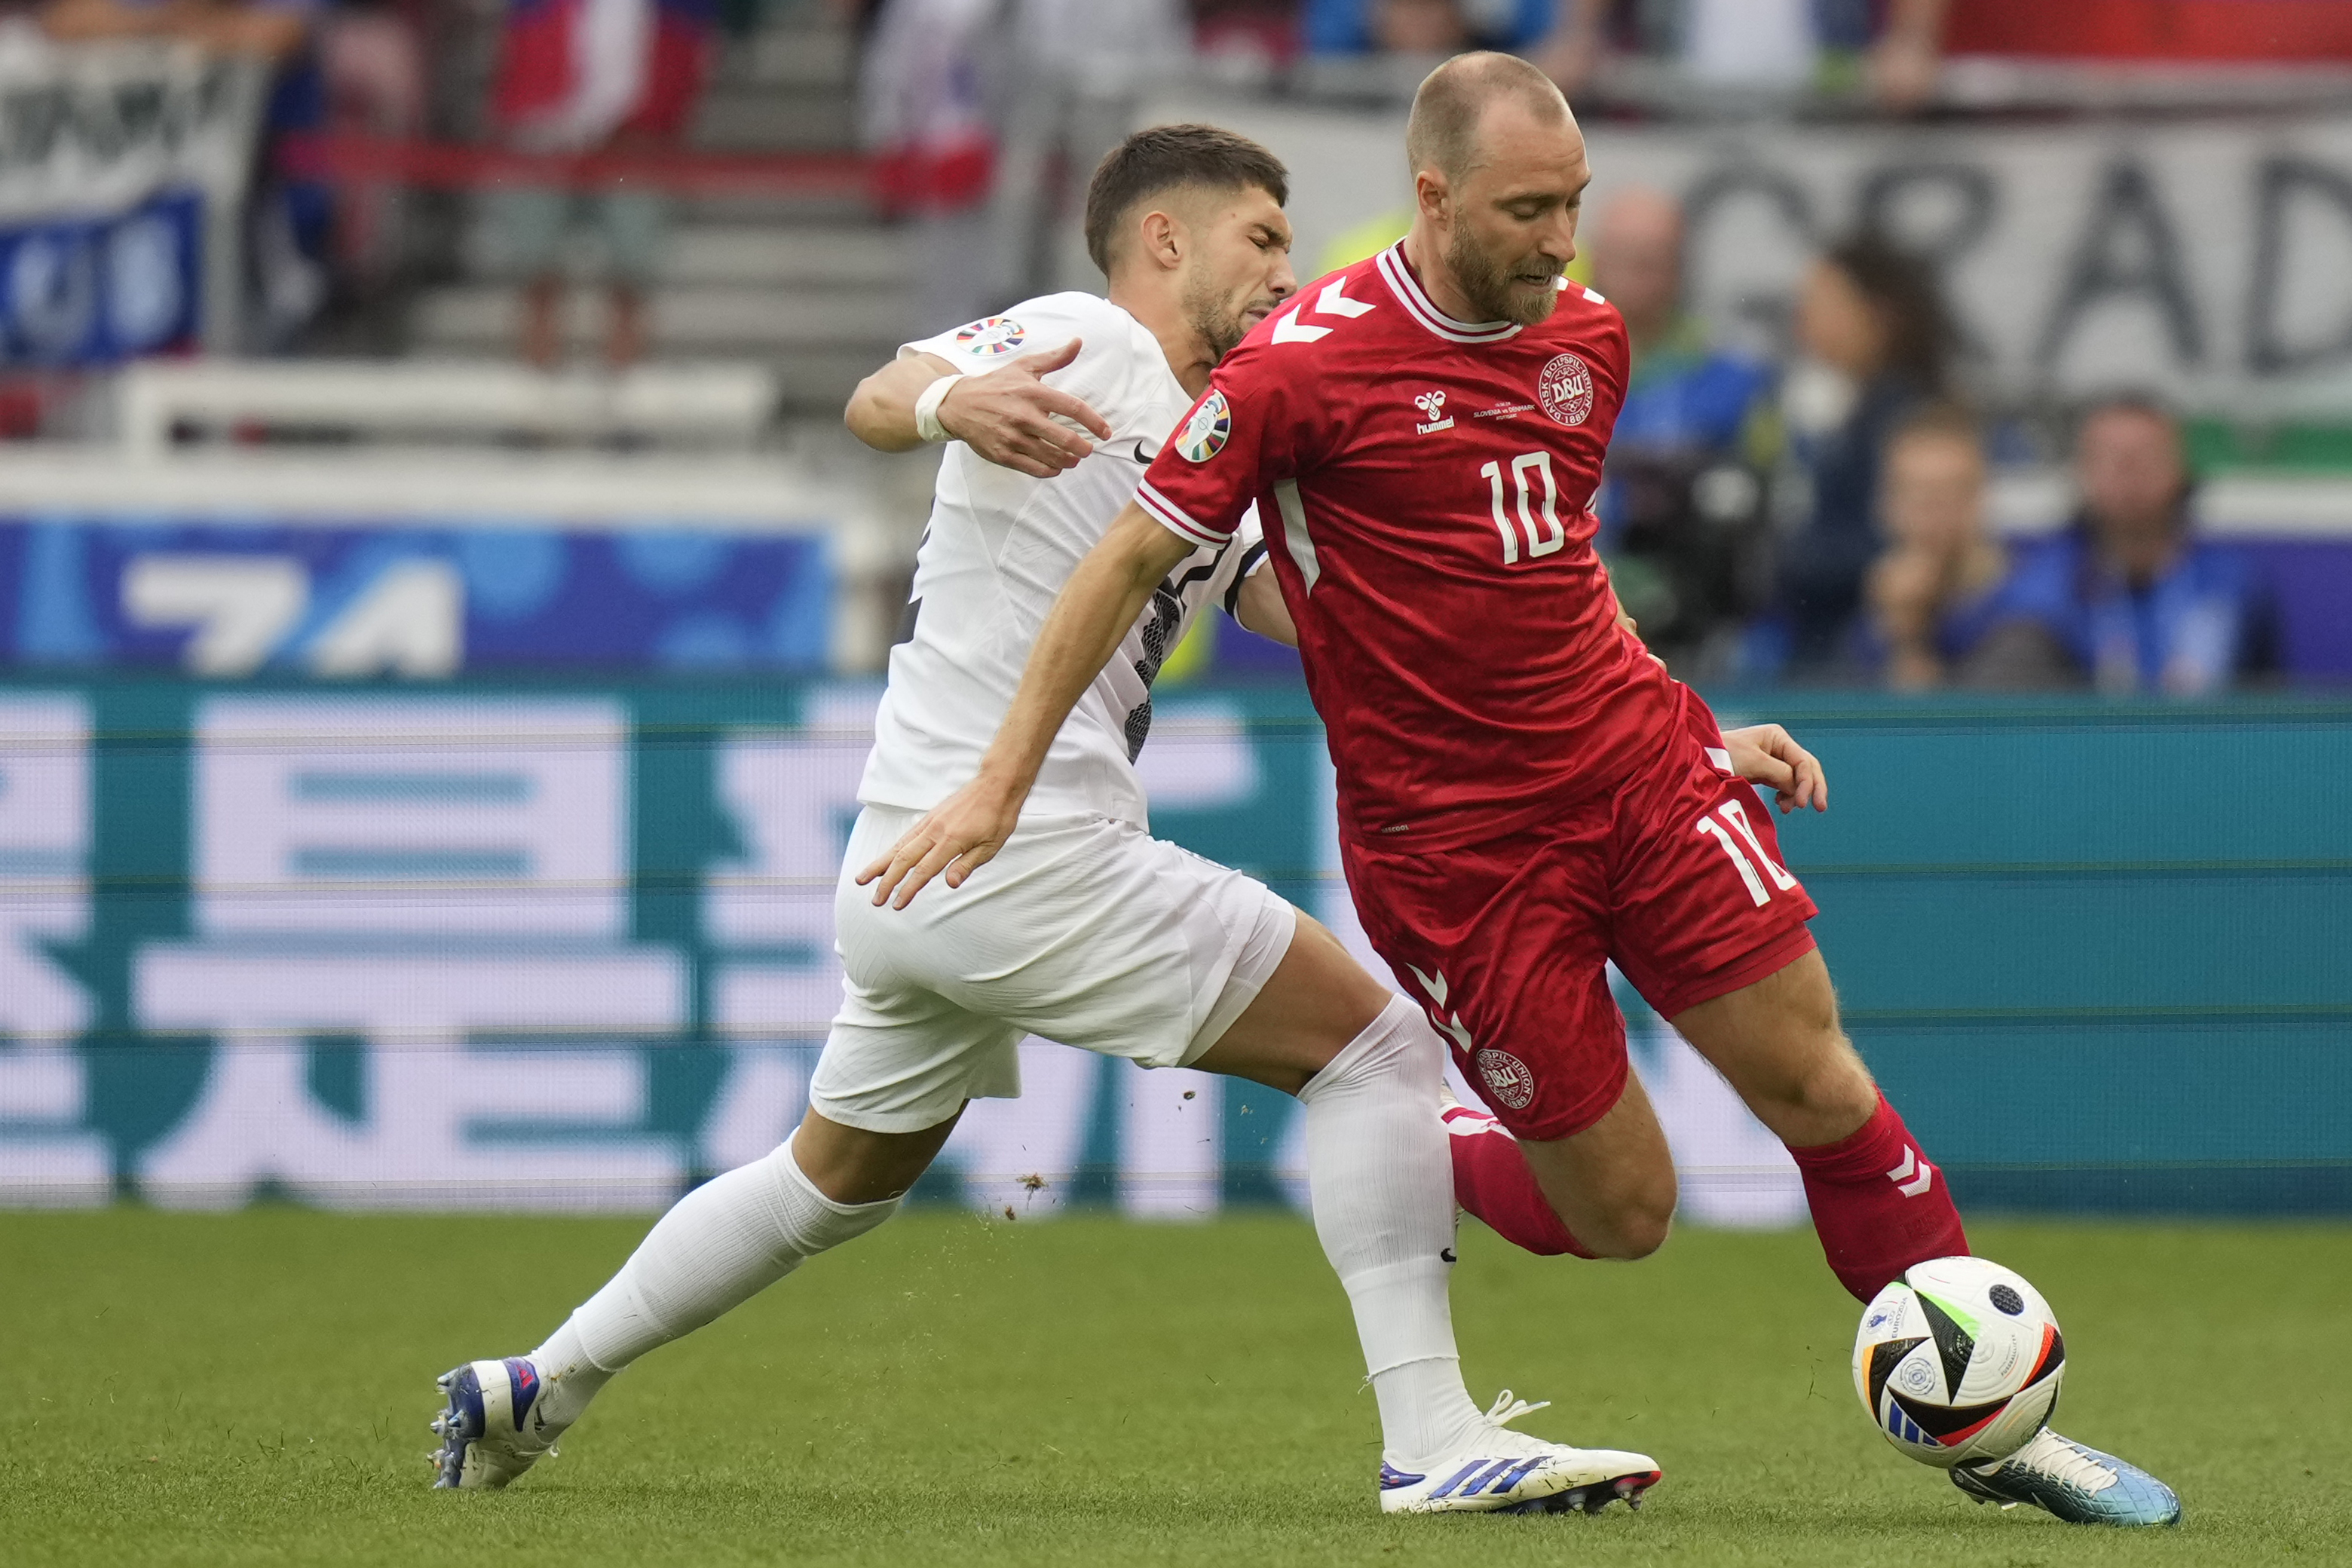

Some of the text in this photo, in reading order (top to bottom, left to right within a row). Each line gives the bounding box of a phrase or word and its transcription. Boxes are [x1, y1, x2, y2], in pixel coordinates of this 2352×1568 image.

[1541, 381, 1561, 421] DANSK
[1551, 375, 1585, 403] DBU
[1416, 415, 1455, 435] hummel
[1473, 409, 1501, 418] SLOVENIA
[1508, 404, 1536, 412] DENMARK
[1565, 409, 1587, 424] 1889
[1480, 450, 1566, 565] 10
[1696, 798, 1797, 908] 10
